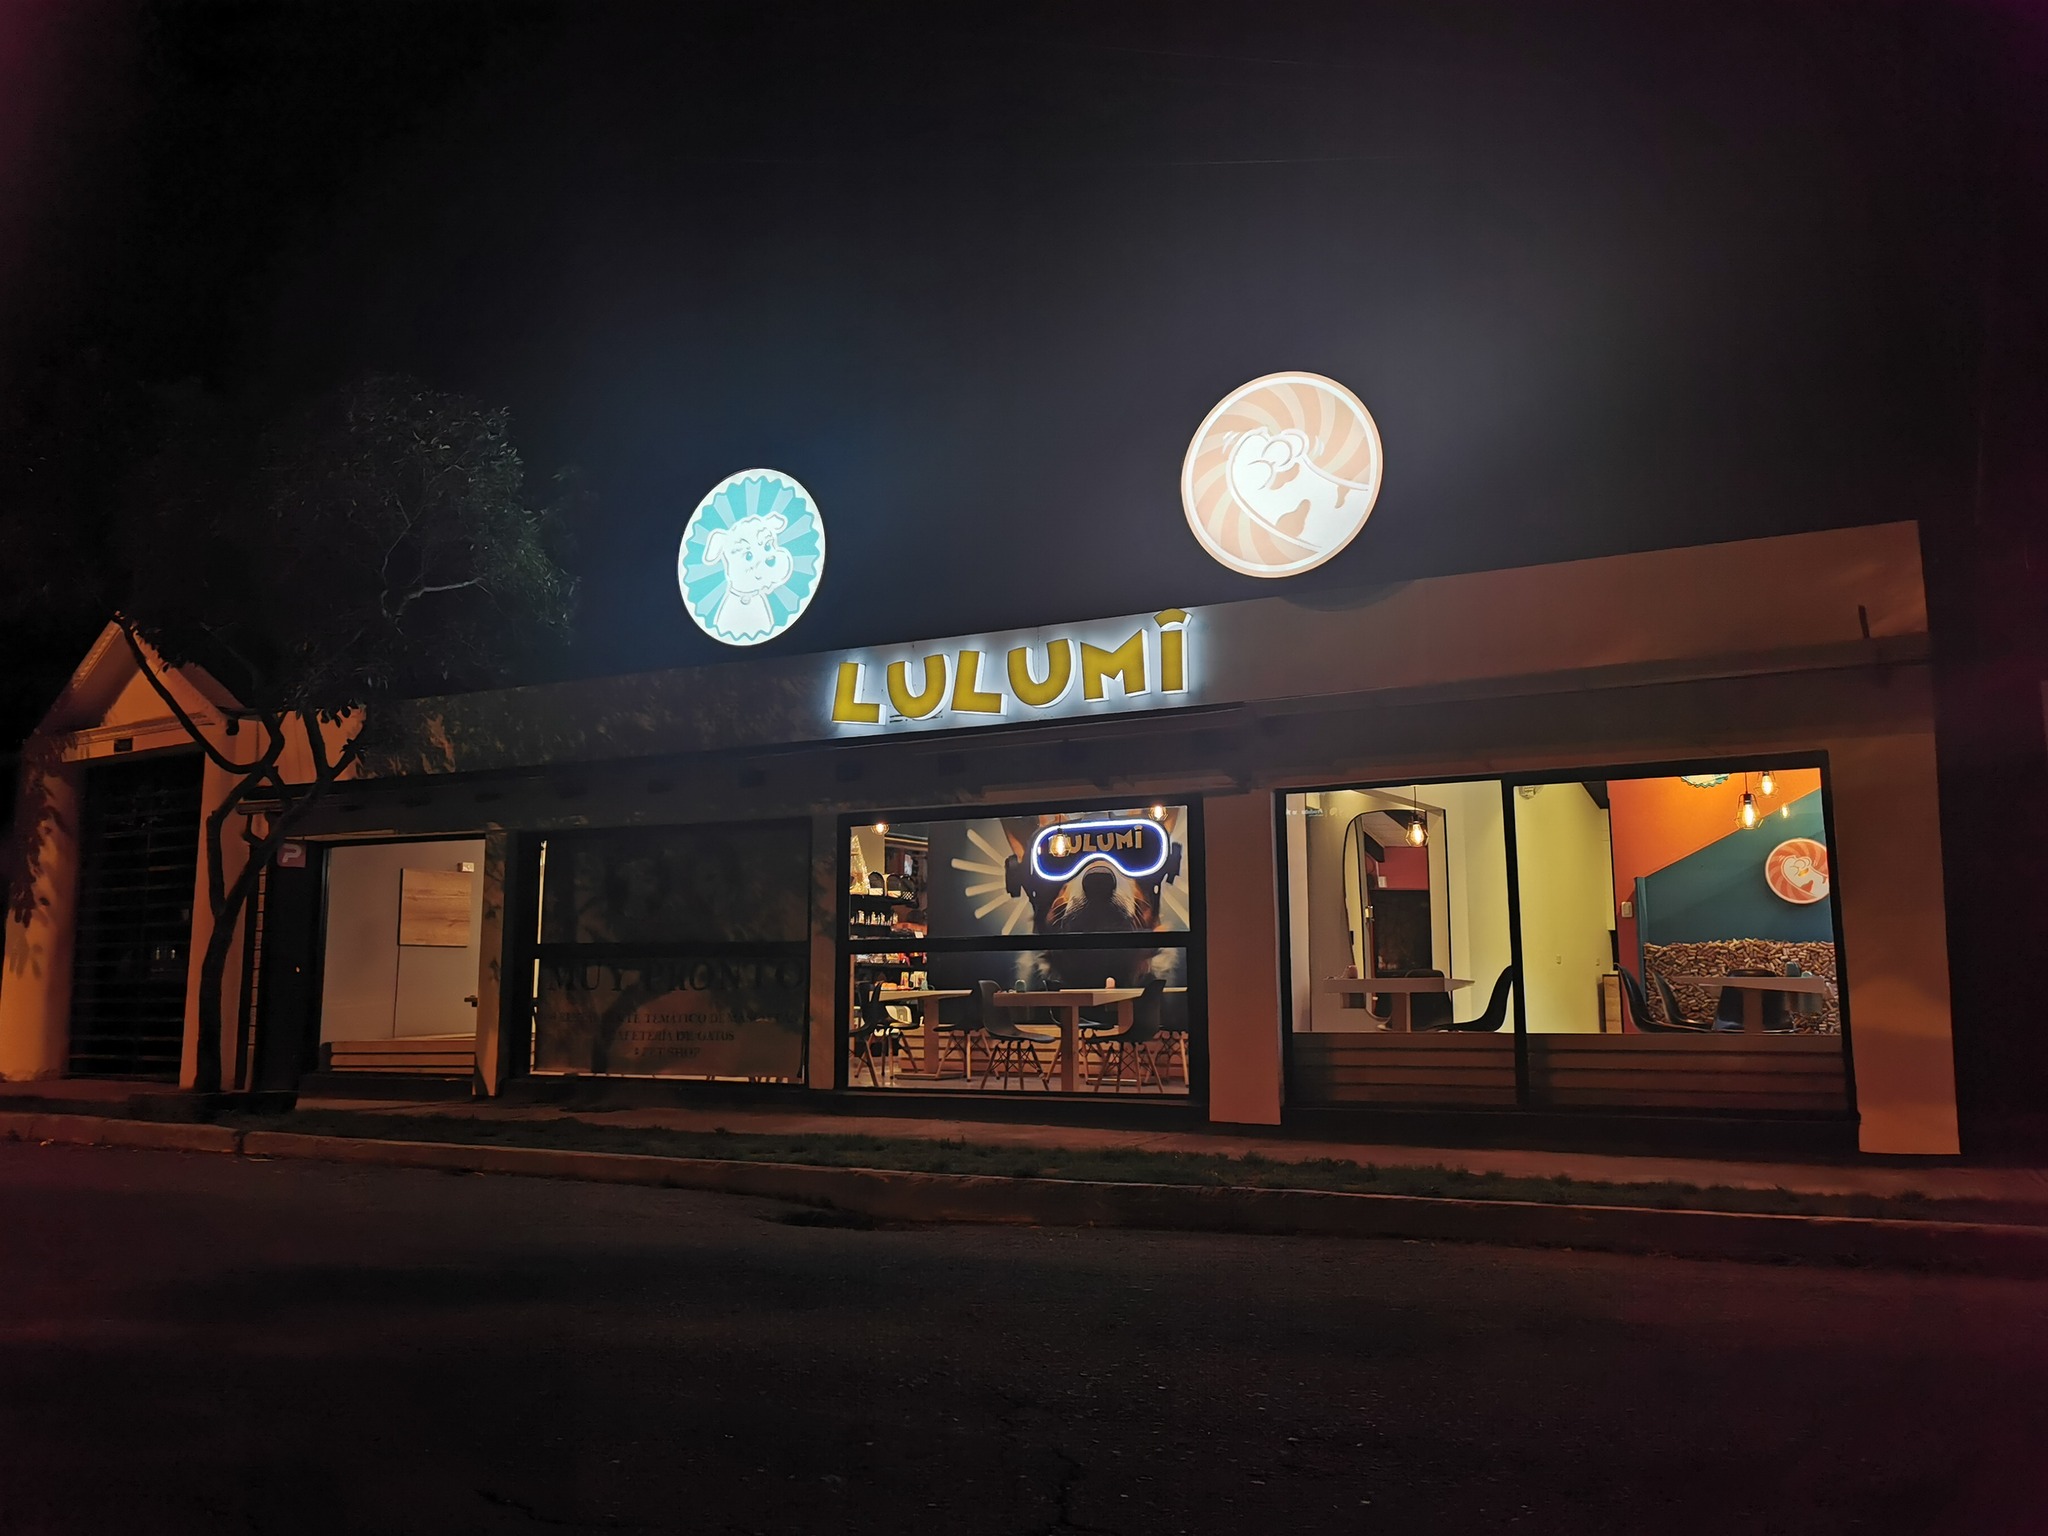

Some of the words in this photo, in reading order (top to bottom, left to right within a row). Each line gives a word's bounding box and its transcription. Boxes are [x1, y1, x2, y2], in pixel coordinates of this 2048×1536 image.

[1048, 824, 1144, 854] ULUMI
[546, 963, 630, 991] MUY
[644, 961, 804, 991] PRONTO
